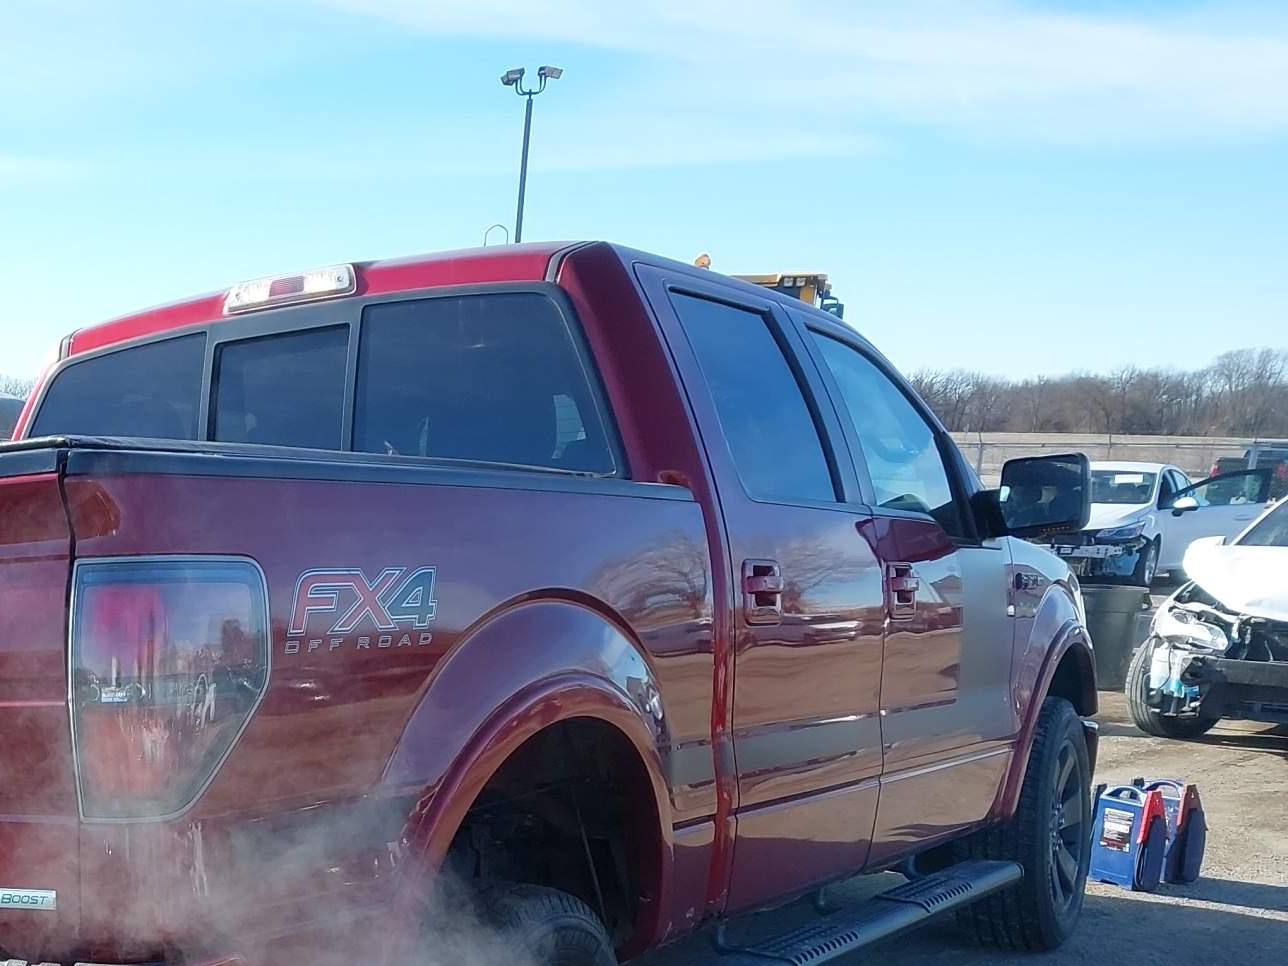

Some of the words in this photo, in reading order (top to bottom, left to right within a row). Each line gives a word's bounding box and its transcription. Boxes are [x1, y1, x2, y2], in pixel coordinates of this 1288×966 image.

[287, 565, 438, 637] FX4
[284, 638, 344, 654] OFF
[356, 632, 433, 650] ROAD
